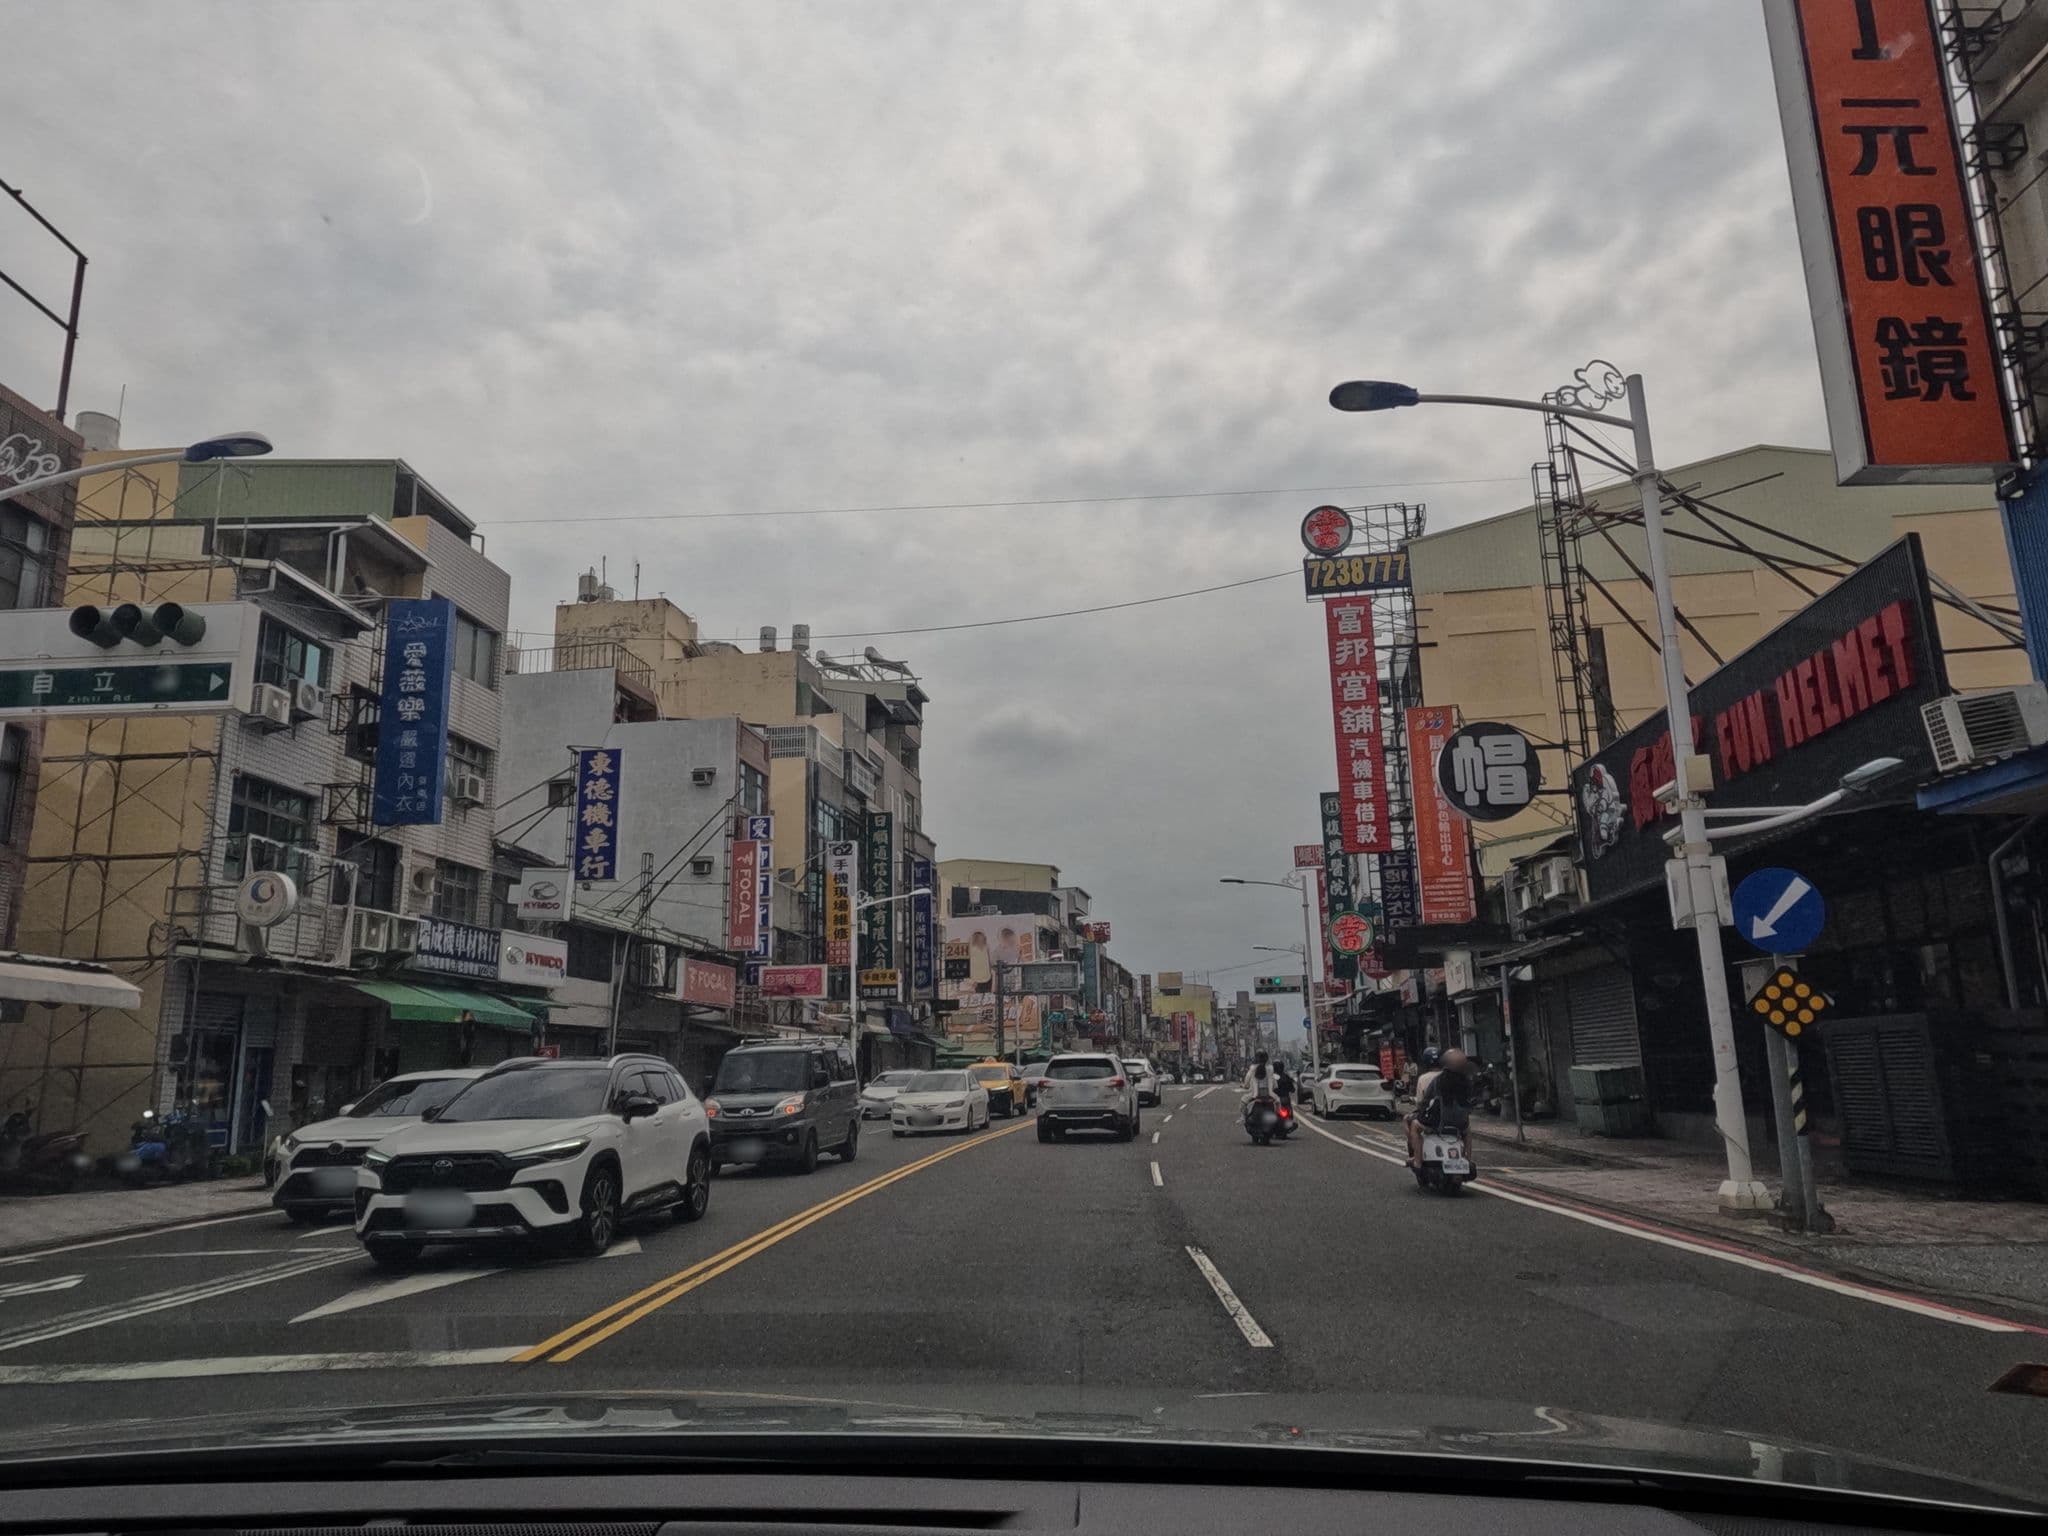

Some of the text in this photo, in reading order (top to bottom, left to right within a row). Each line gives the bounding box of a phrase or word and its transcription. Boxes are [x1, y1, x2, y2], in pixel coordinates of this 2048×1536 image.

[1307, 554, 1407, 588] 7238777
[1717, 690, 1775, 781] FUN
[1776, 601, 1914, 749] HELMET
[1452, 734, 1530, 807] 帽
[523, 901, 561, 910] KYMCO
[739, 868, 752, 924] FOCAL
[525, 951, 563, 969] KYMCO
